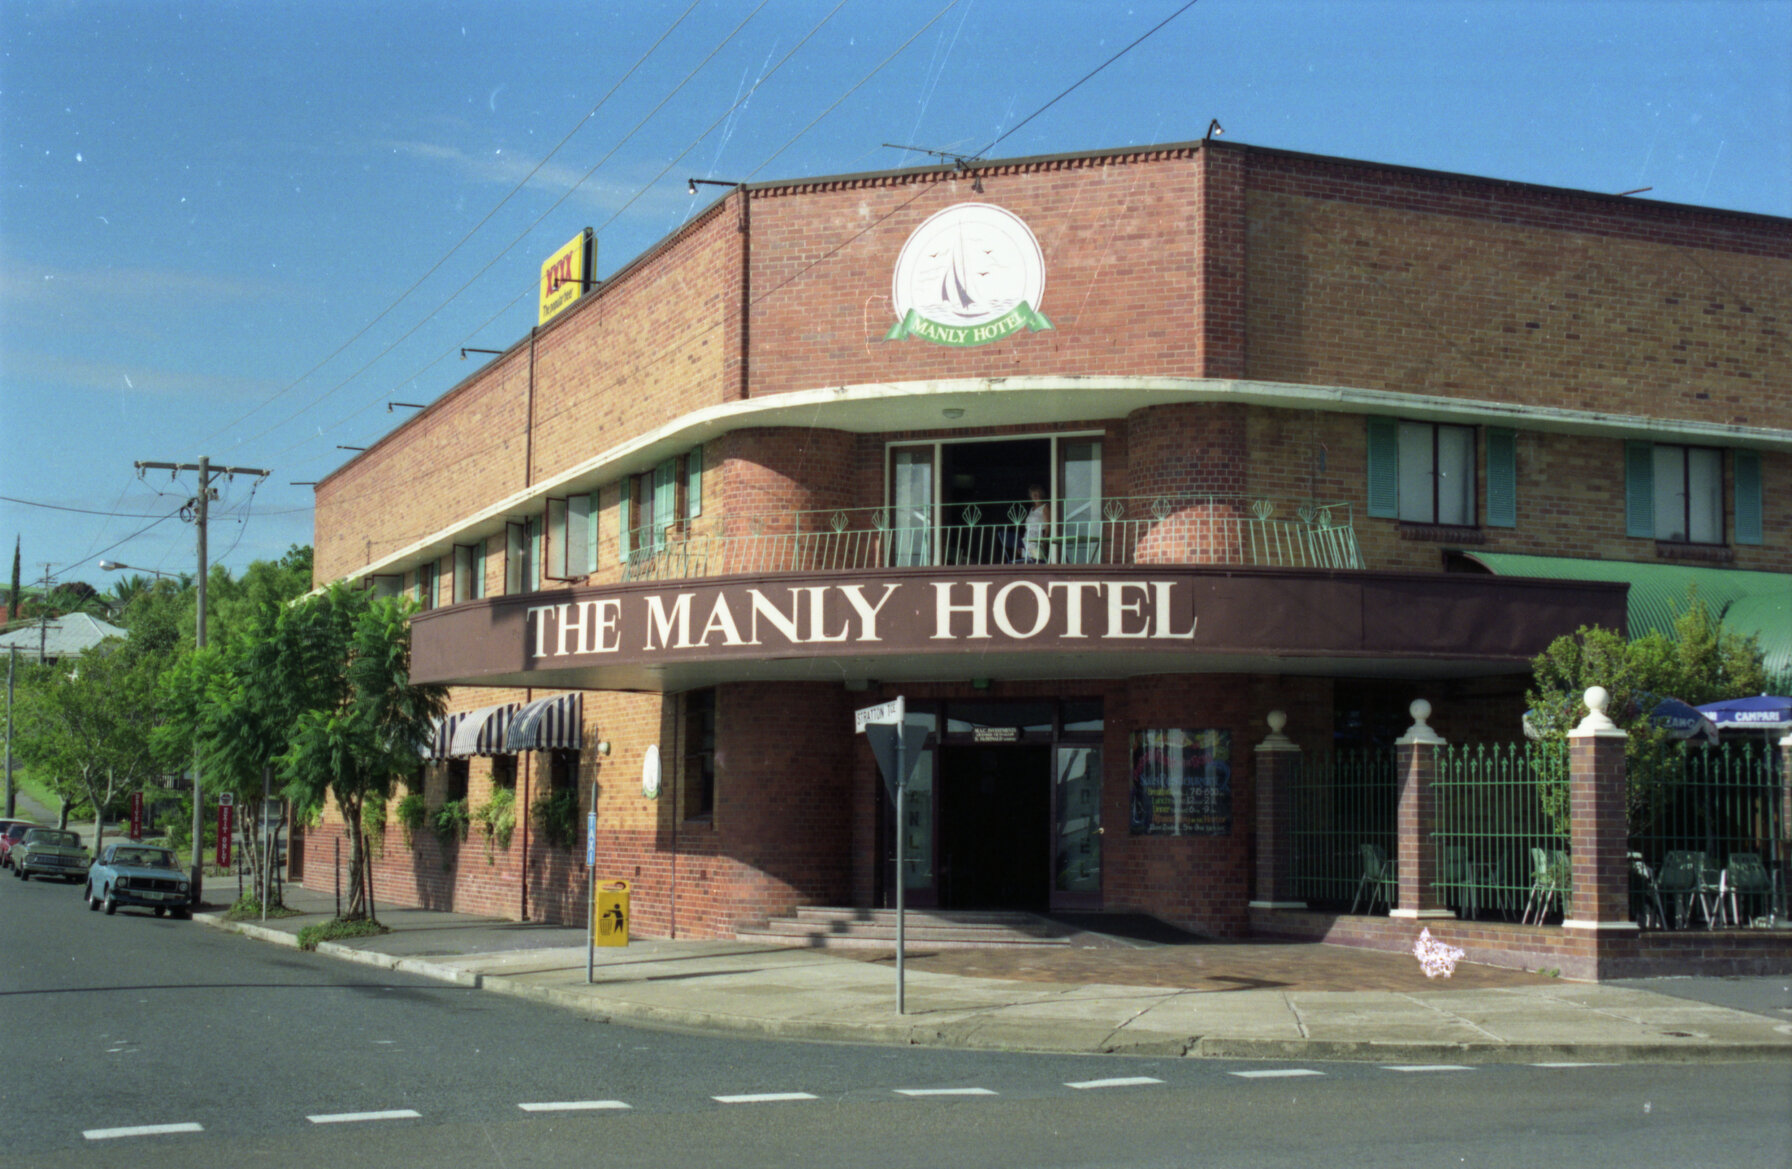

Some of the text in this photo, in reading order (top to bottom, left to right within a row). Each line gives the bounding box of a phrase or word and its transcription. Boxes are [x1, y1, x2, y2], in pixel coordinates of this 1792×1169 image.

[912, 313, 1026, 343] MANLY HOTEL
[527, 580, 1197, 658] THE MANLY HOTEL
[856, 706, 884, 726] STRATTON
[1649, 714, 1696, 729] IZANO
[1735, 711, 1780, 722] CAMPARI
